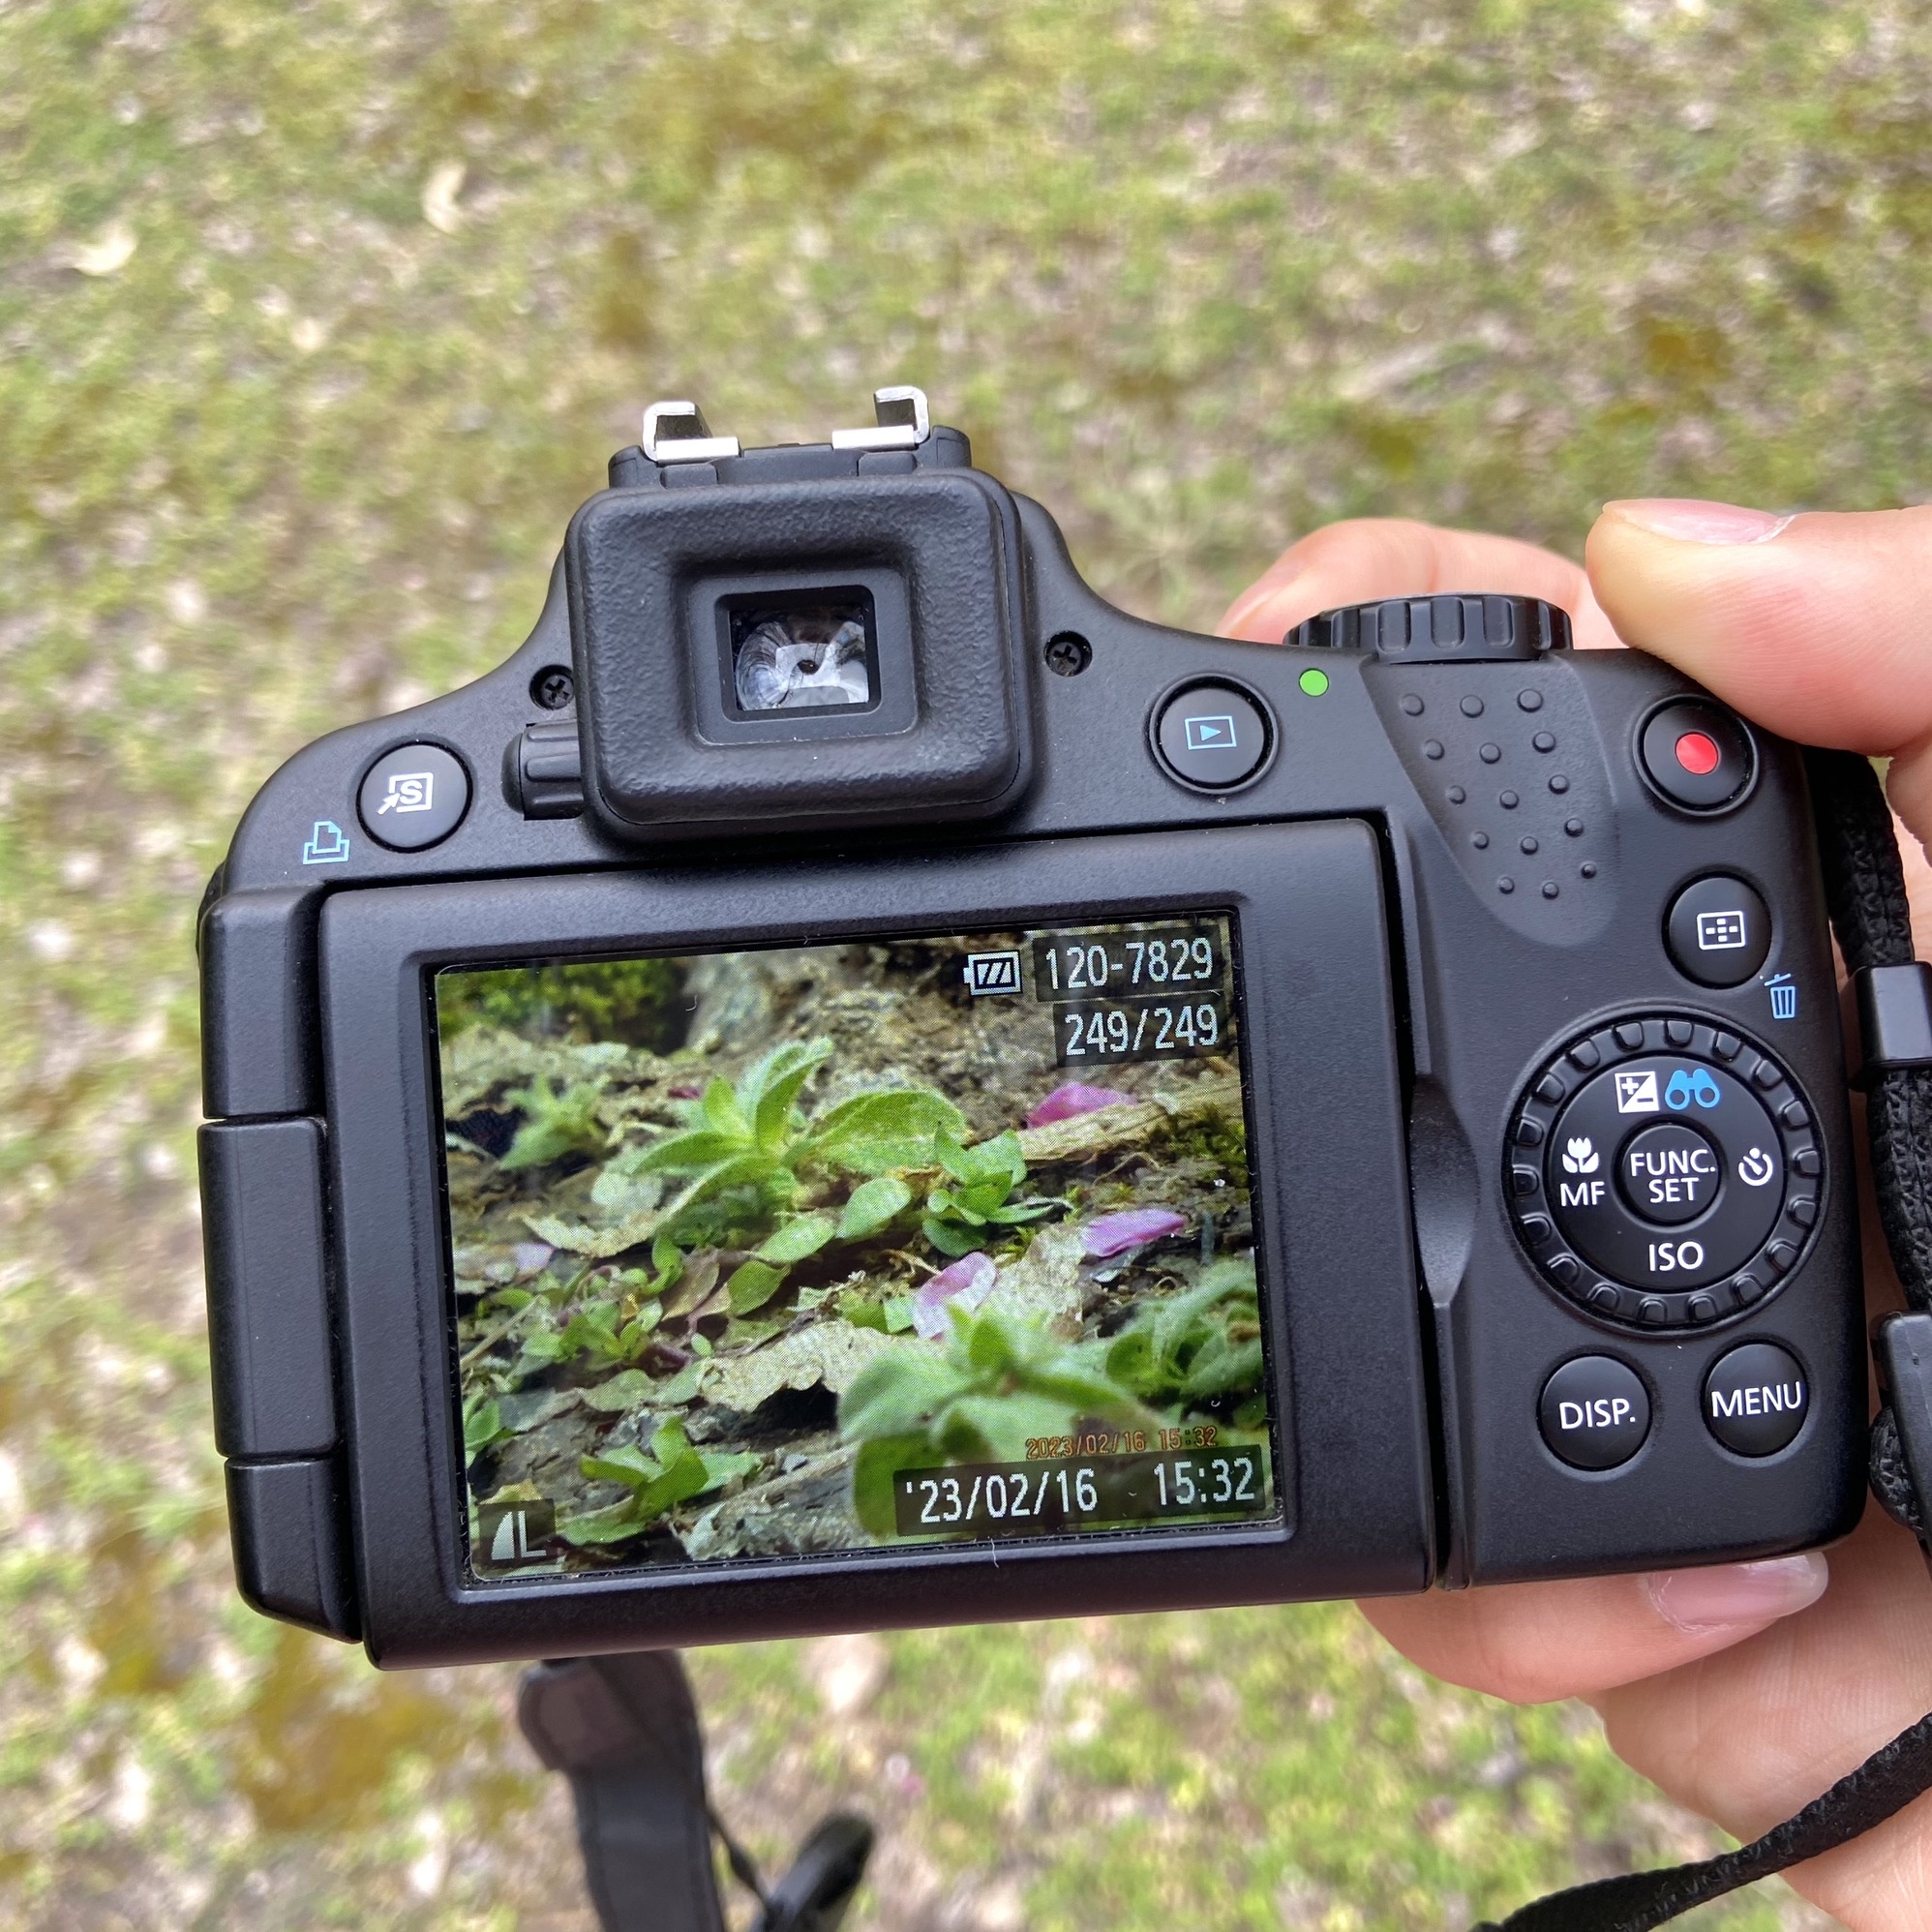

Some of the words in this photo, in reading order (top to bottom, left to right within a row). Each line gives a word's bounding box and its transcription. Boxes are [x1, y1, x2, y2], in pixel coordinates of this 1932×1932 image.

[1045, 937, 1213, 990] 120-7829
[1065, 1004, 1219, 1056] 249/249
[1630, 1149, 1716, 1177] FUNC.
[1559, 1181, 1606, 1207] MF
[1648, 1177, 1700, 1203] SET
[1648, 1241, 1704, 1272] ISO
[1558, 1398, 1636, 1430] DISP.
[1710, 1380, 1802, 1418] MENU
[1026, 1431, 1145, 1460] 2023/02/16
[1159, 1426, 1219, 1451] 15:32
[906, 1467, 1098, 1524] '23/02/16
[1154, 1457, 1255, 1506] 15:32
